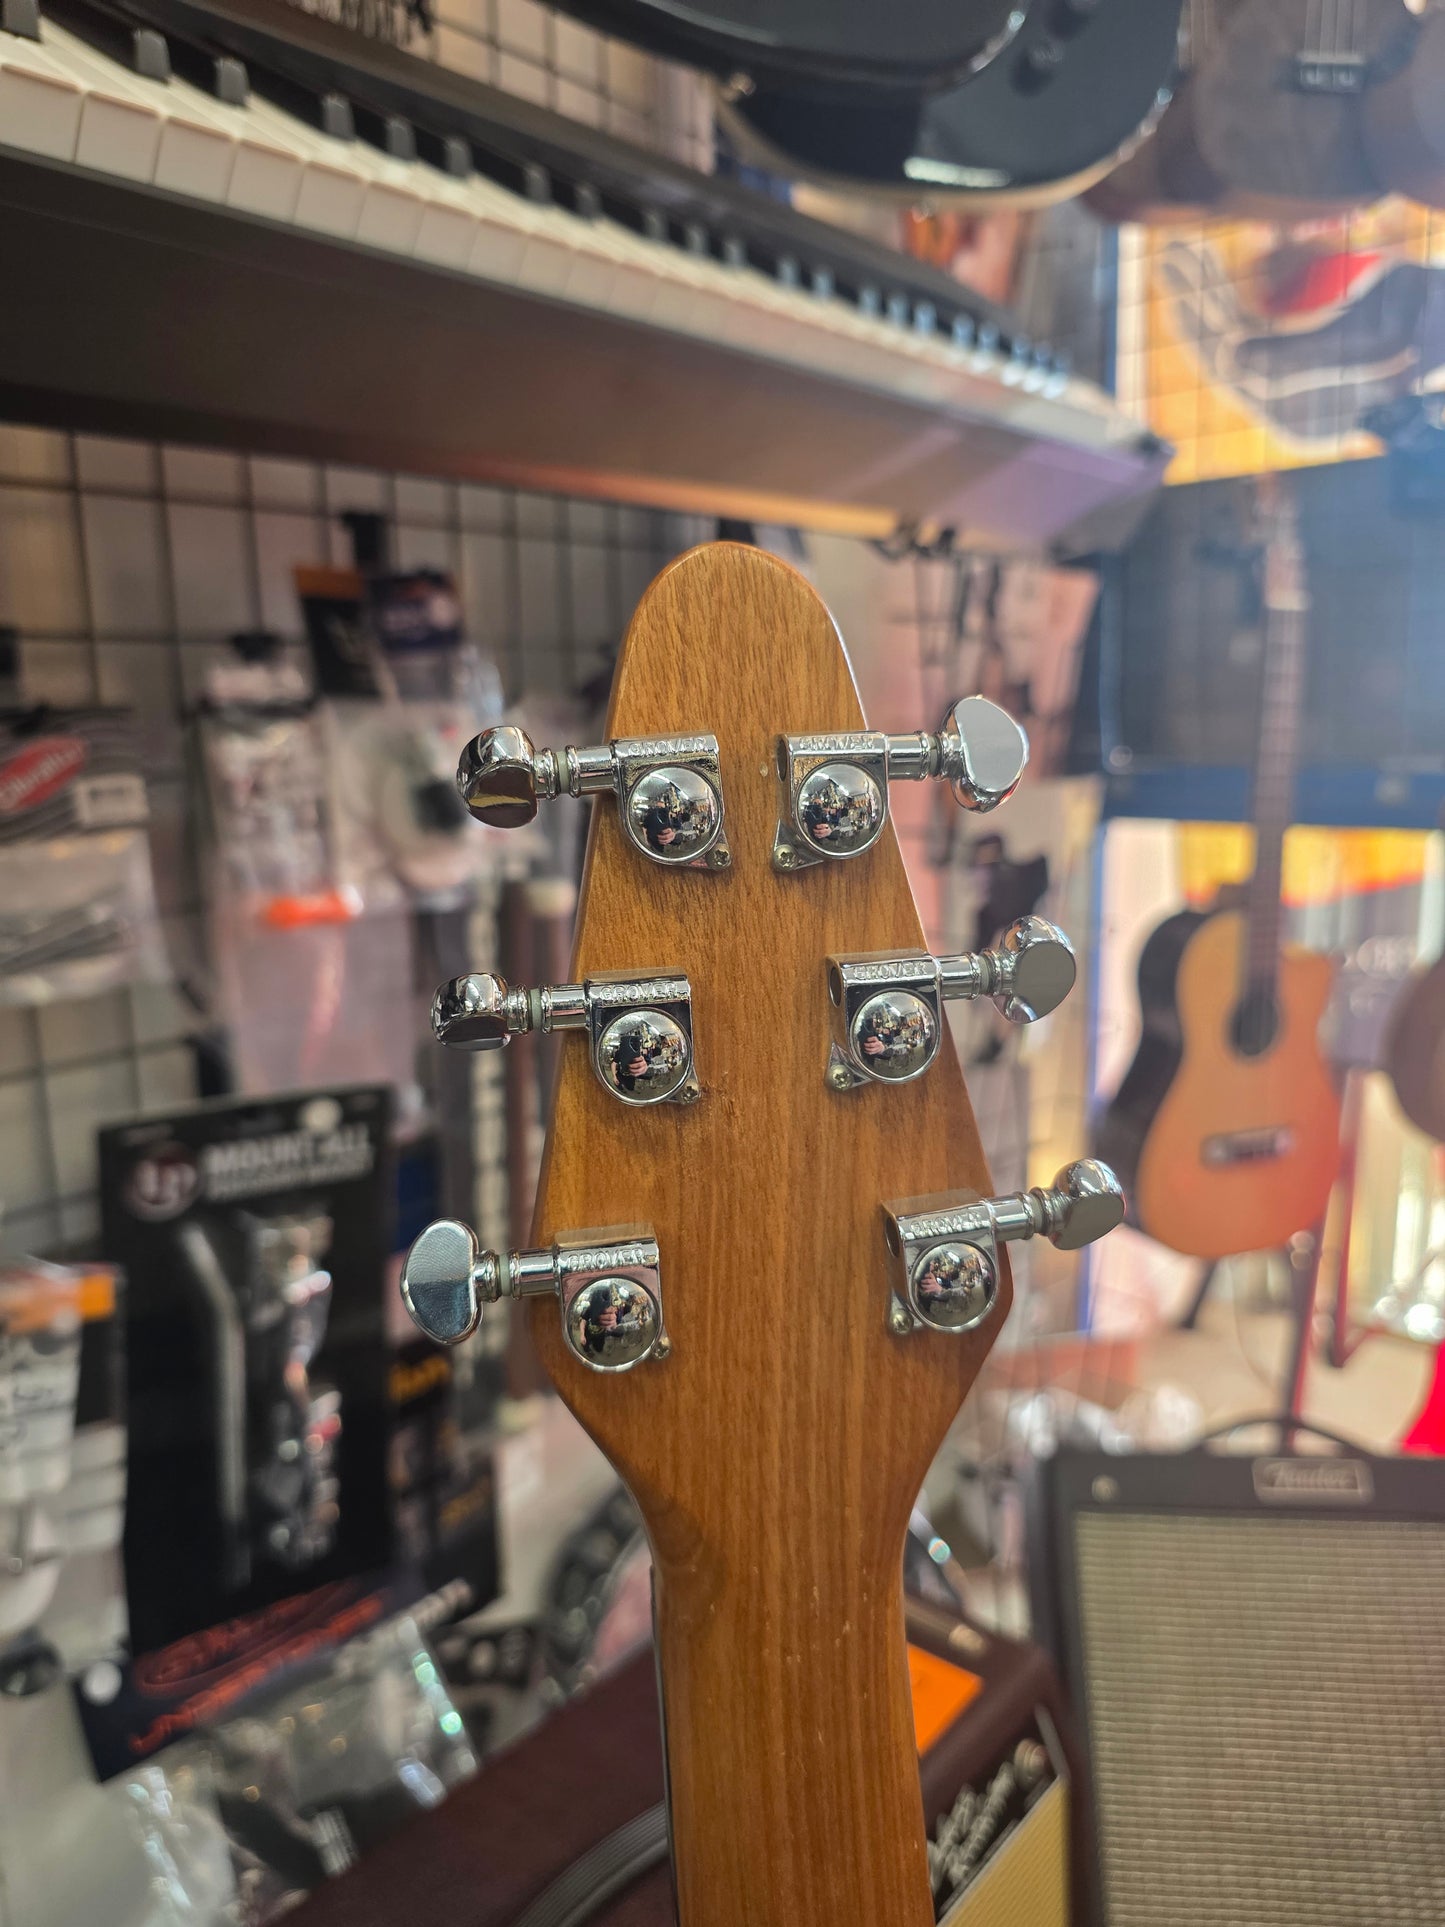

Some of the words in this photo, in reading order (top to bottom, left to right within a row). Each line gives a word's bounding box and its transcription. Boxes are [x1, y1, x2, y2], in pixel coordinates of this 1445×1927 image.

[629, 737, 706, 757] GROVER
[799, 735, 875, 751] GROVER
[854, 960, 928, 981] GROVER
[600, 981, 677, 1003] GROVER
[911, 1211, 982, 1238] GROVER
[567, 1246, 646, 1271] GROVER
